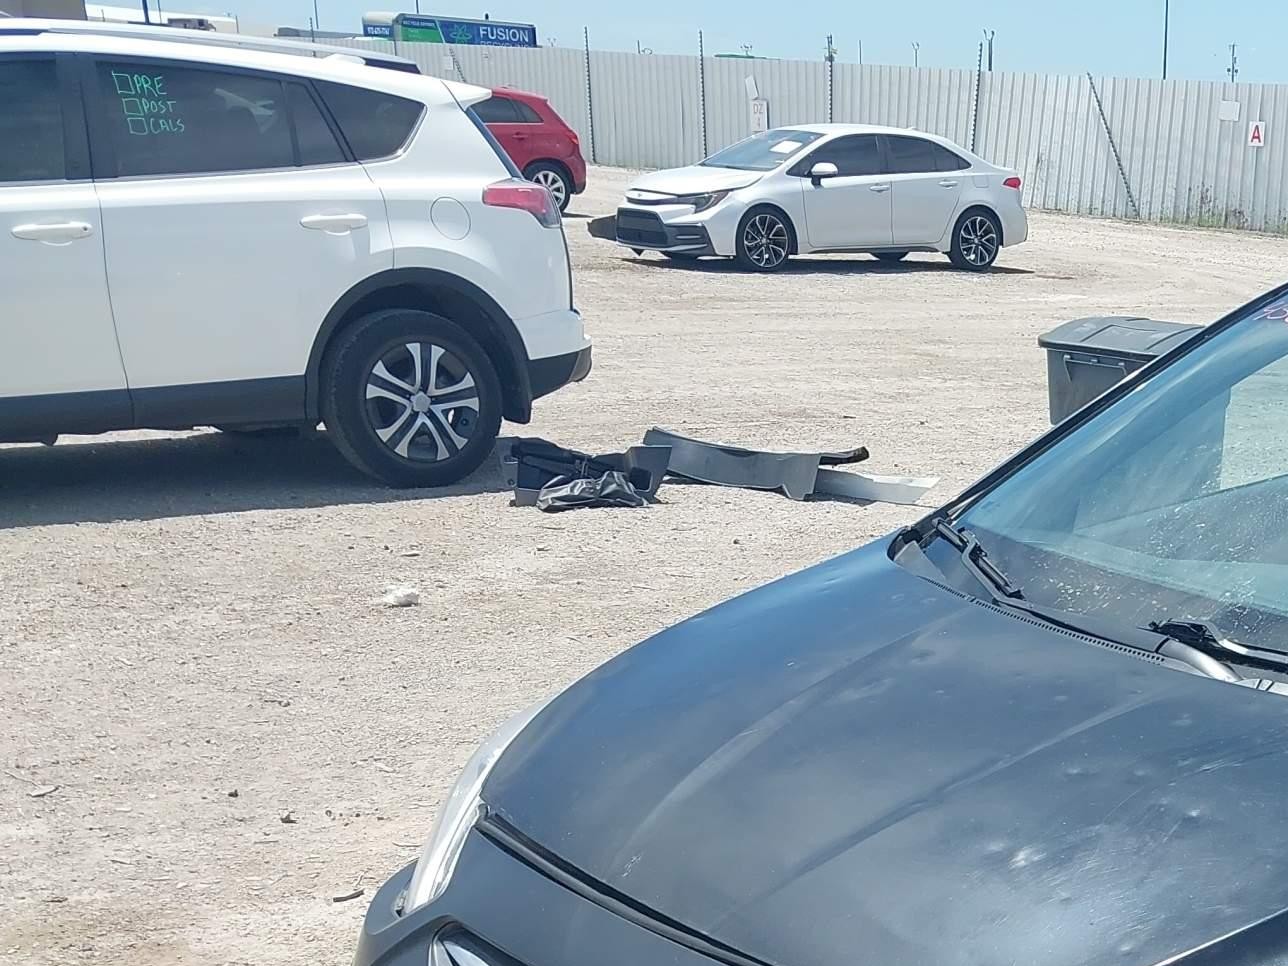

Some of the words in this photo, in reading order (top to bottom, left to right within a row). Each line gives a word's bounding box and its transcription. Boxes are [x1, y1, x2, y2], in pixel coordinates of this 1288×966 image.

[479, 26, 529, 42] FUSION
[133, 74, 167, 97] PRE
[141, 98, 176, 114] POST
[150, 117, 185, 134] CALS
[1250, 124, 1261, 143] A
